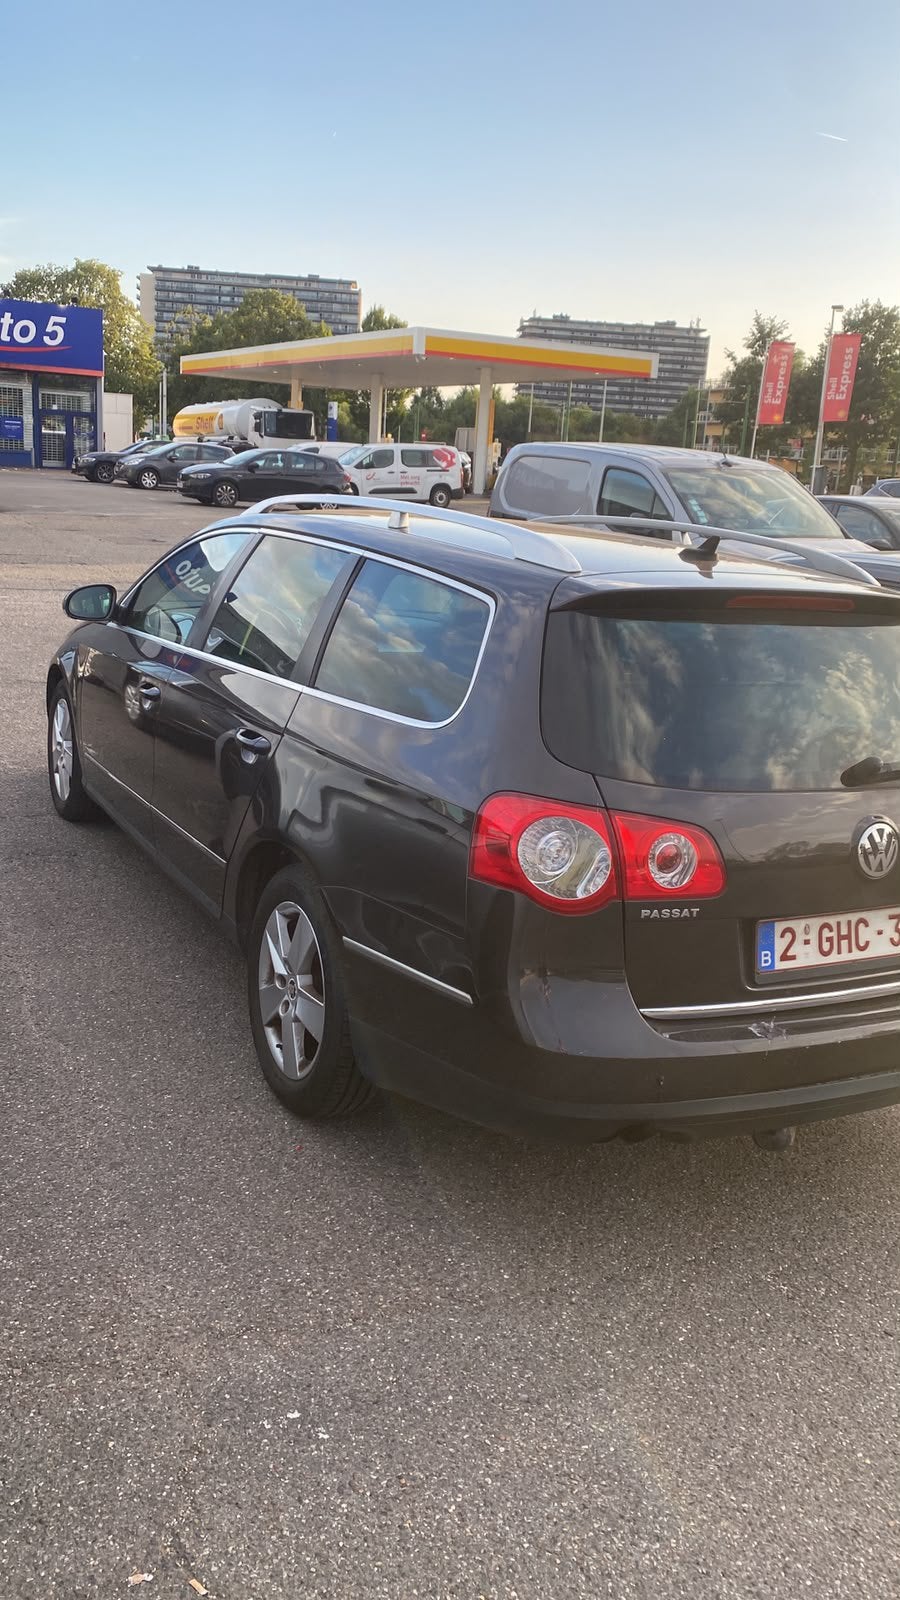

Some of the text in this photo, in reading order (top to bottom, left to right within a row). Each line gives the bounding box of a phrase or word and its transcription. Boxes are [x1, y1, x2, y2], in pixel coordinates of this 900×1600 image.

[43, 315, 67, 346] 5
[771, 354, 789, 405] Express
[835, 347, 854, 400] Express
[763, 382, 774, 404] Shell
[827, 377, 838, 400] Shell
[195, 415, 215, 430] Shell
[640, 908, 700, 919] PASSAT
[761, 950, 772, 967] B
